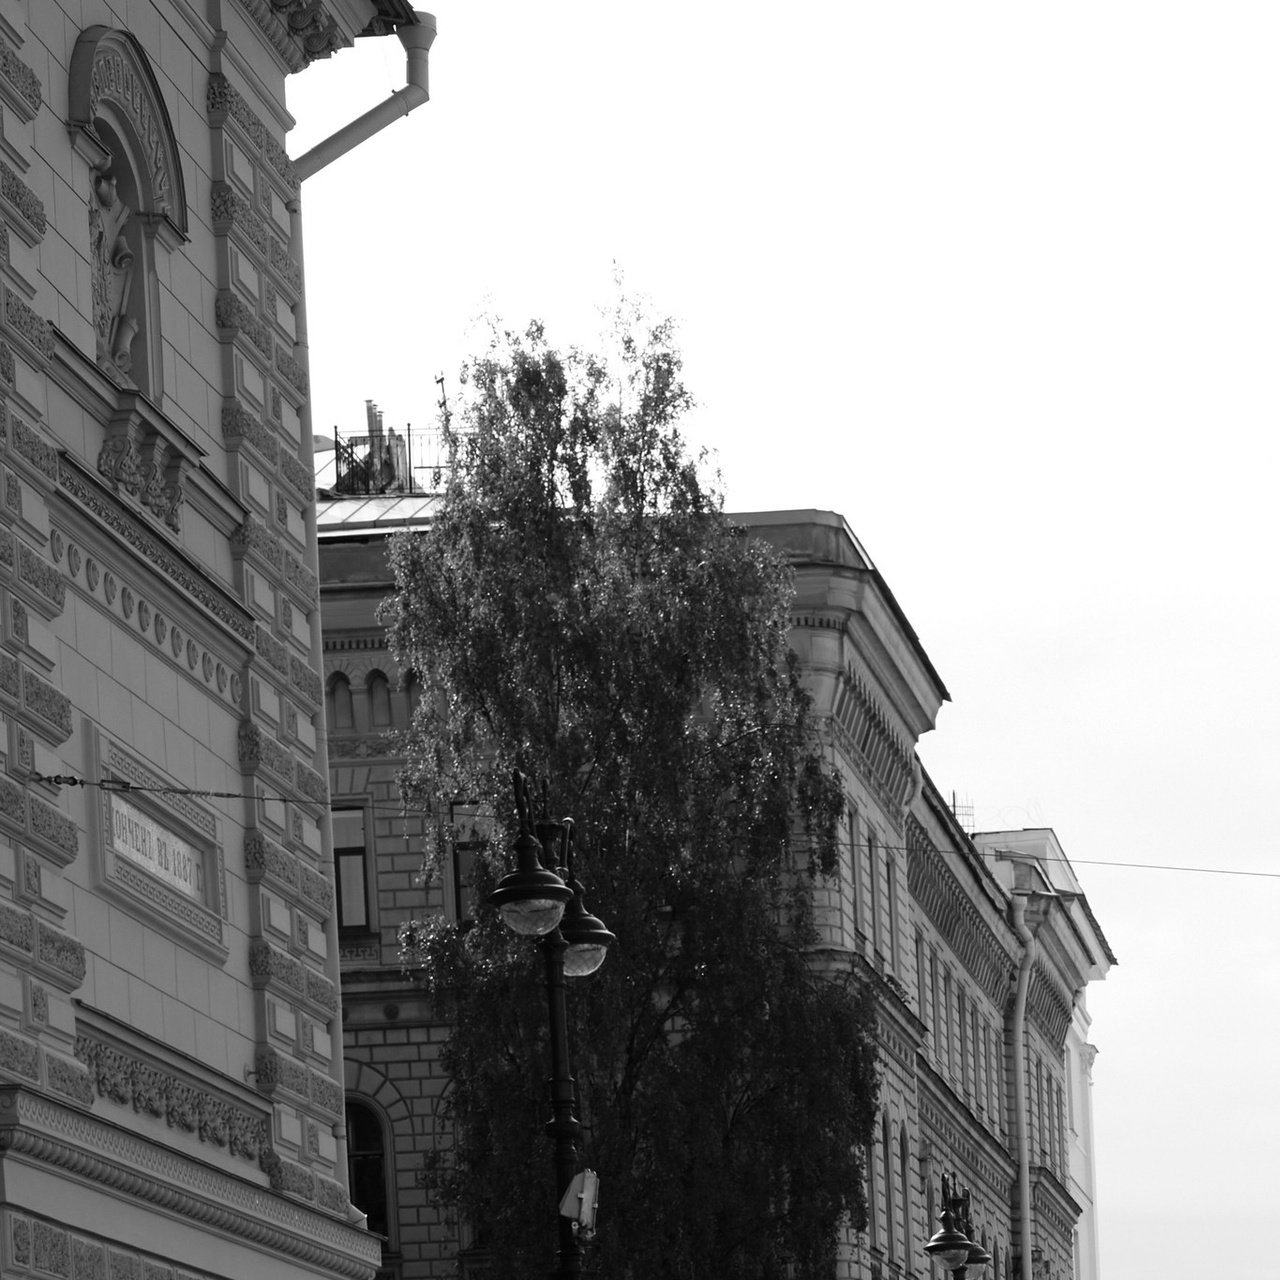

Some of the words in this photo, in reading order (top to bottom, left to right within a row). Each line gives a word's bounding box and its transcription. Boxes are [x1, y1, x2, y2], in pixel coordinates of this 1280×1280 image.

[113, 806, 154, 862] ОНЧЕНЪ
[156, 837, 169, 872] ВЪ
[172, 848, 192, 886] 1887
